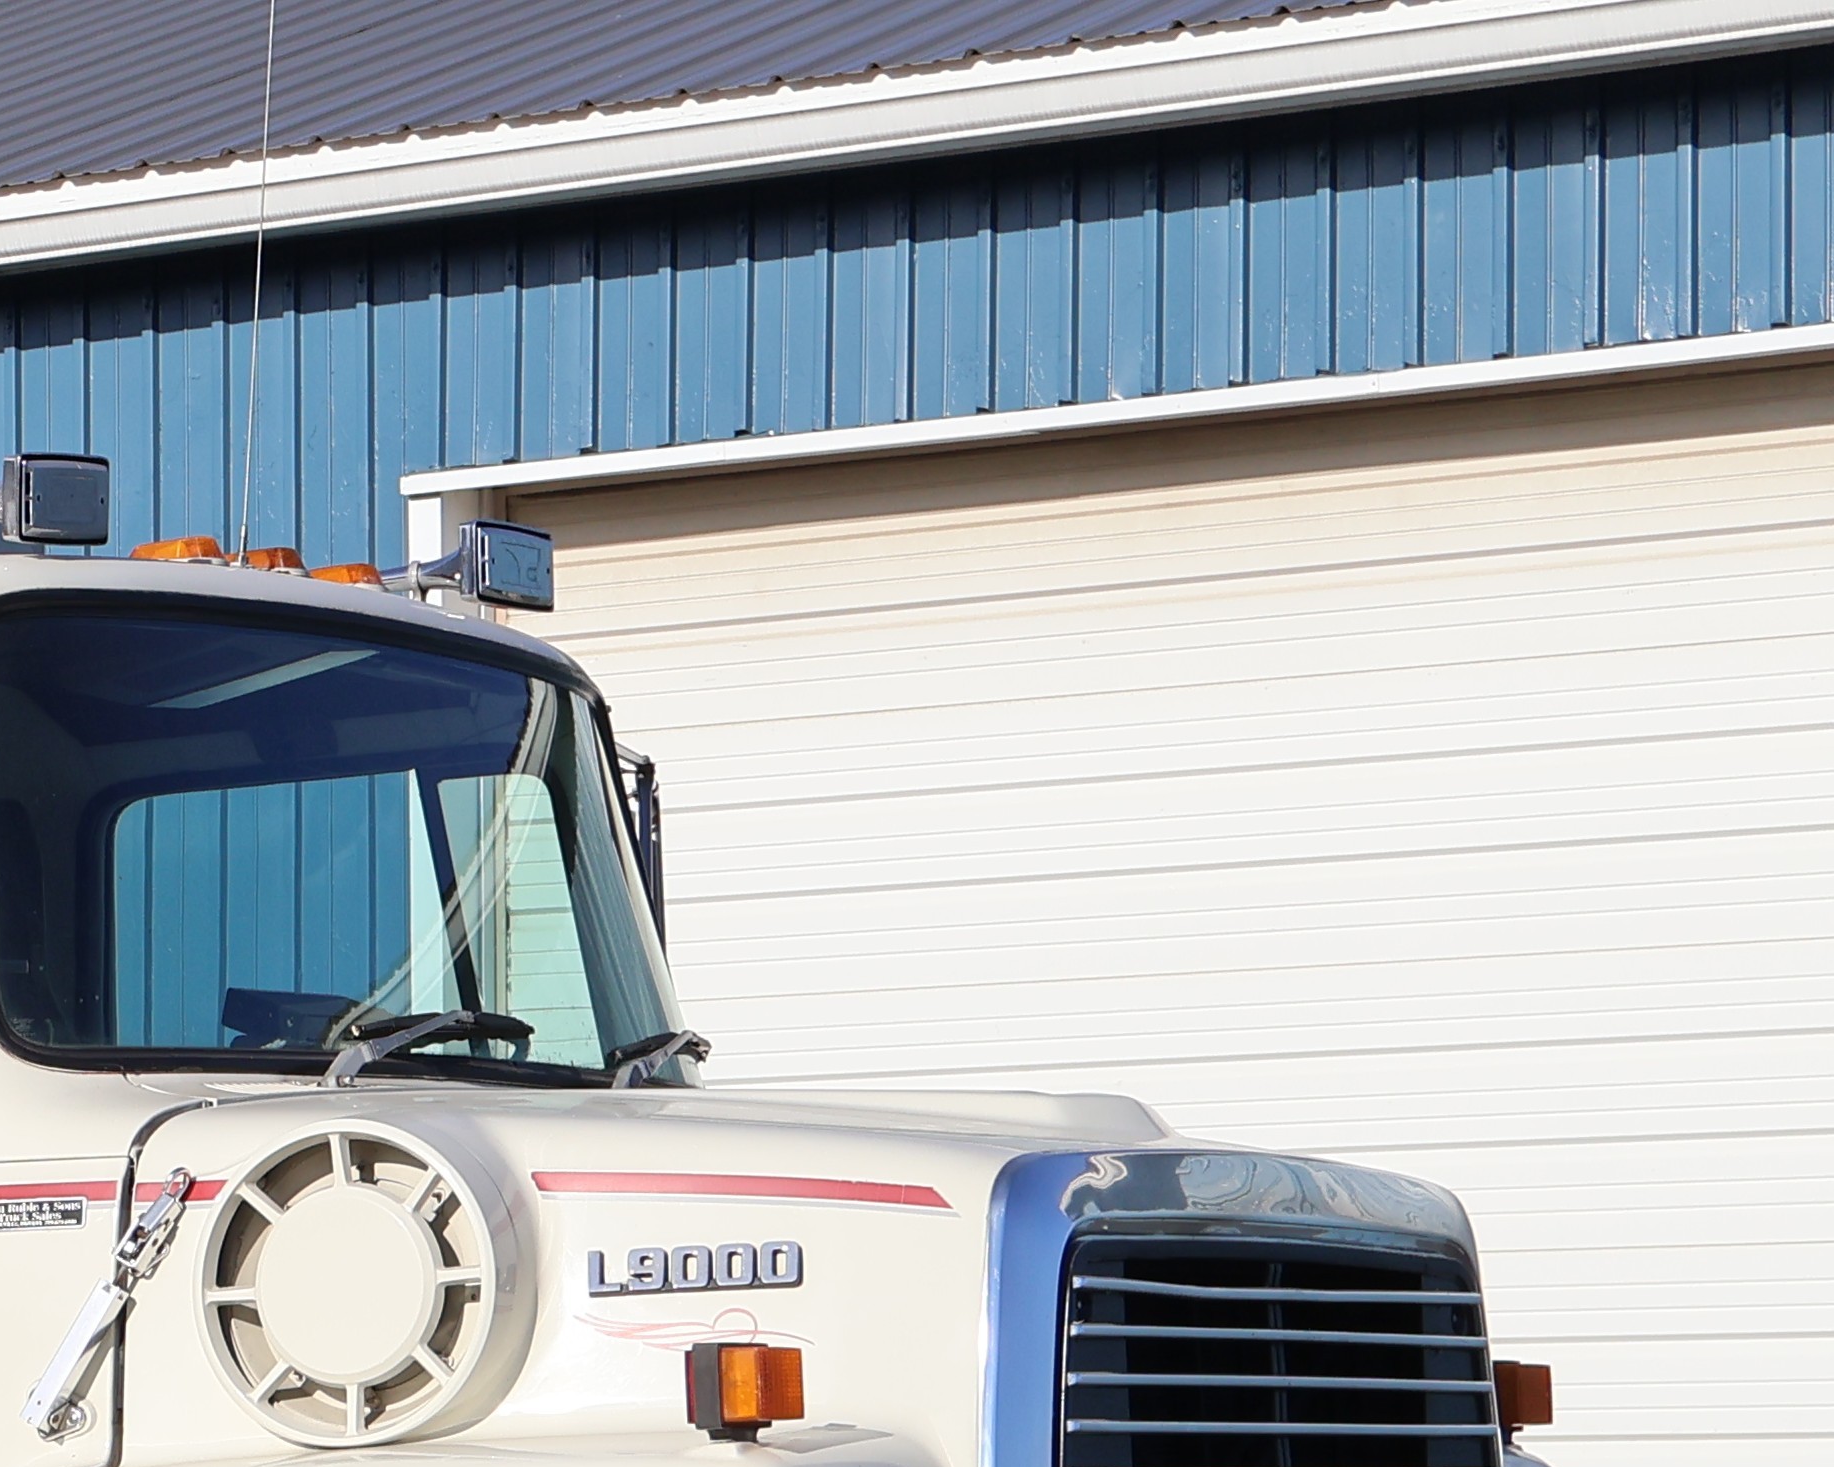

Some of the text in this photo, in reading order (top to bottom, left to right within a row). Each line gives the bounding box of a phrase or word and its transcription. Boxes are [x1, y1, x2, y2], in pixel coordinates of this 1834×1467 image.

[42, 1202, 50, 1211] &
[53, 1201, 81, 1212] Sons
[32, 1211, 62, 1221] Sales
[587, 1240, 804, 1298] L9000
